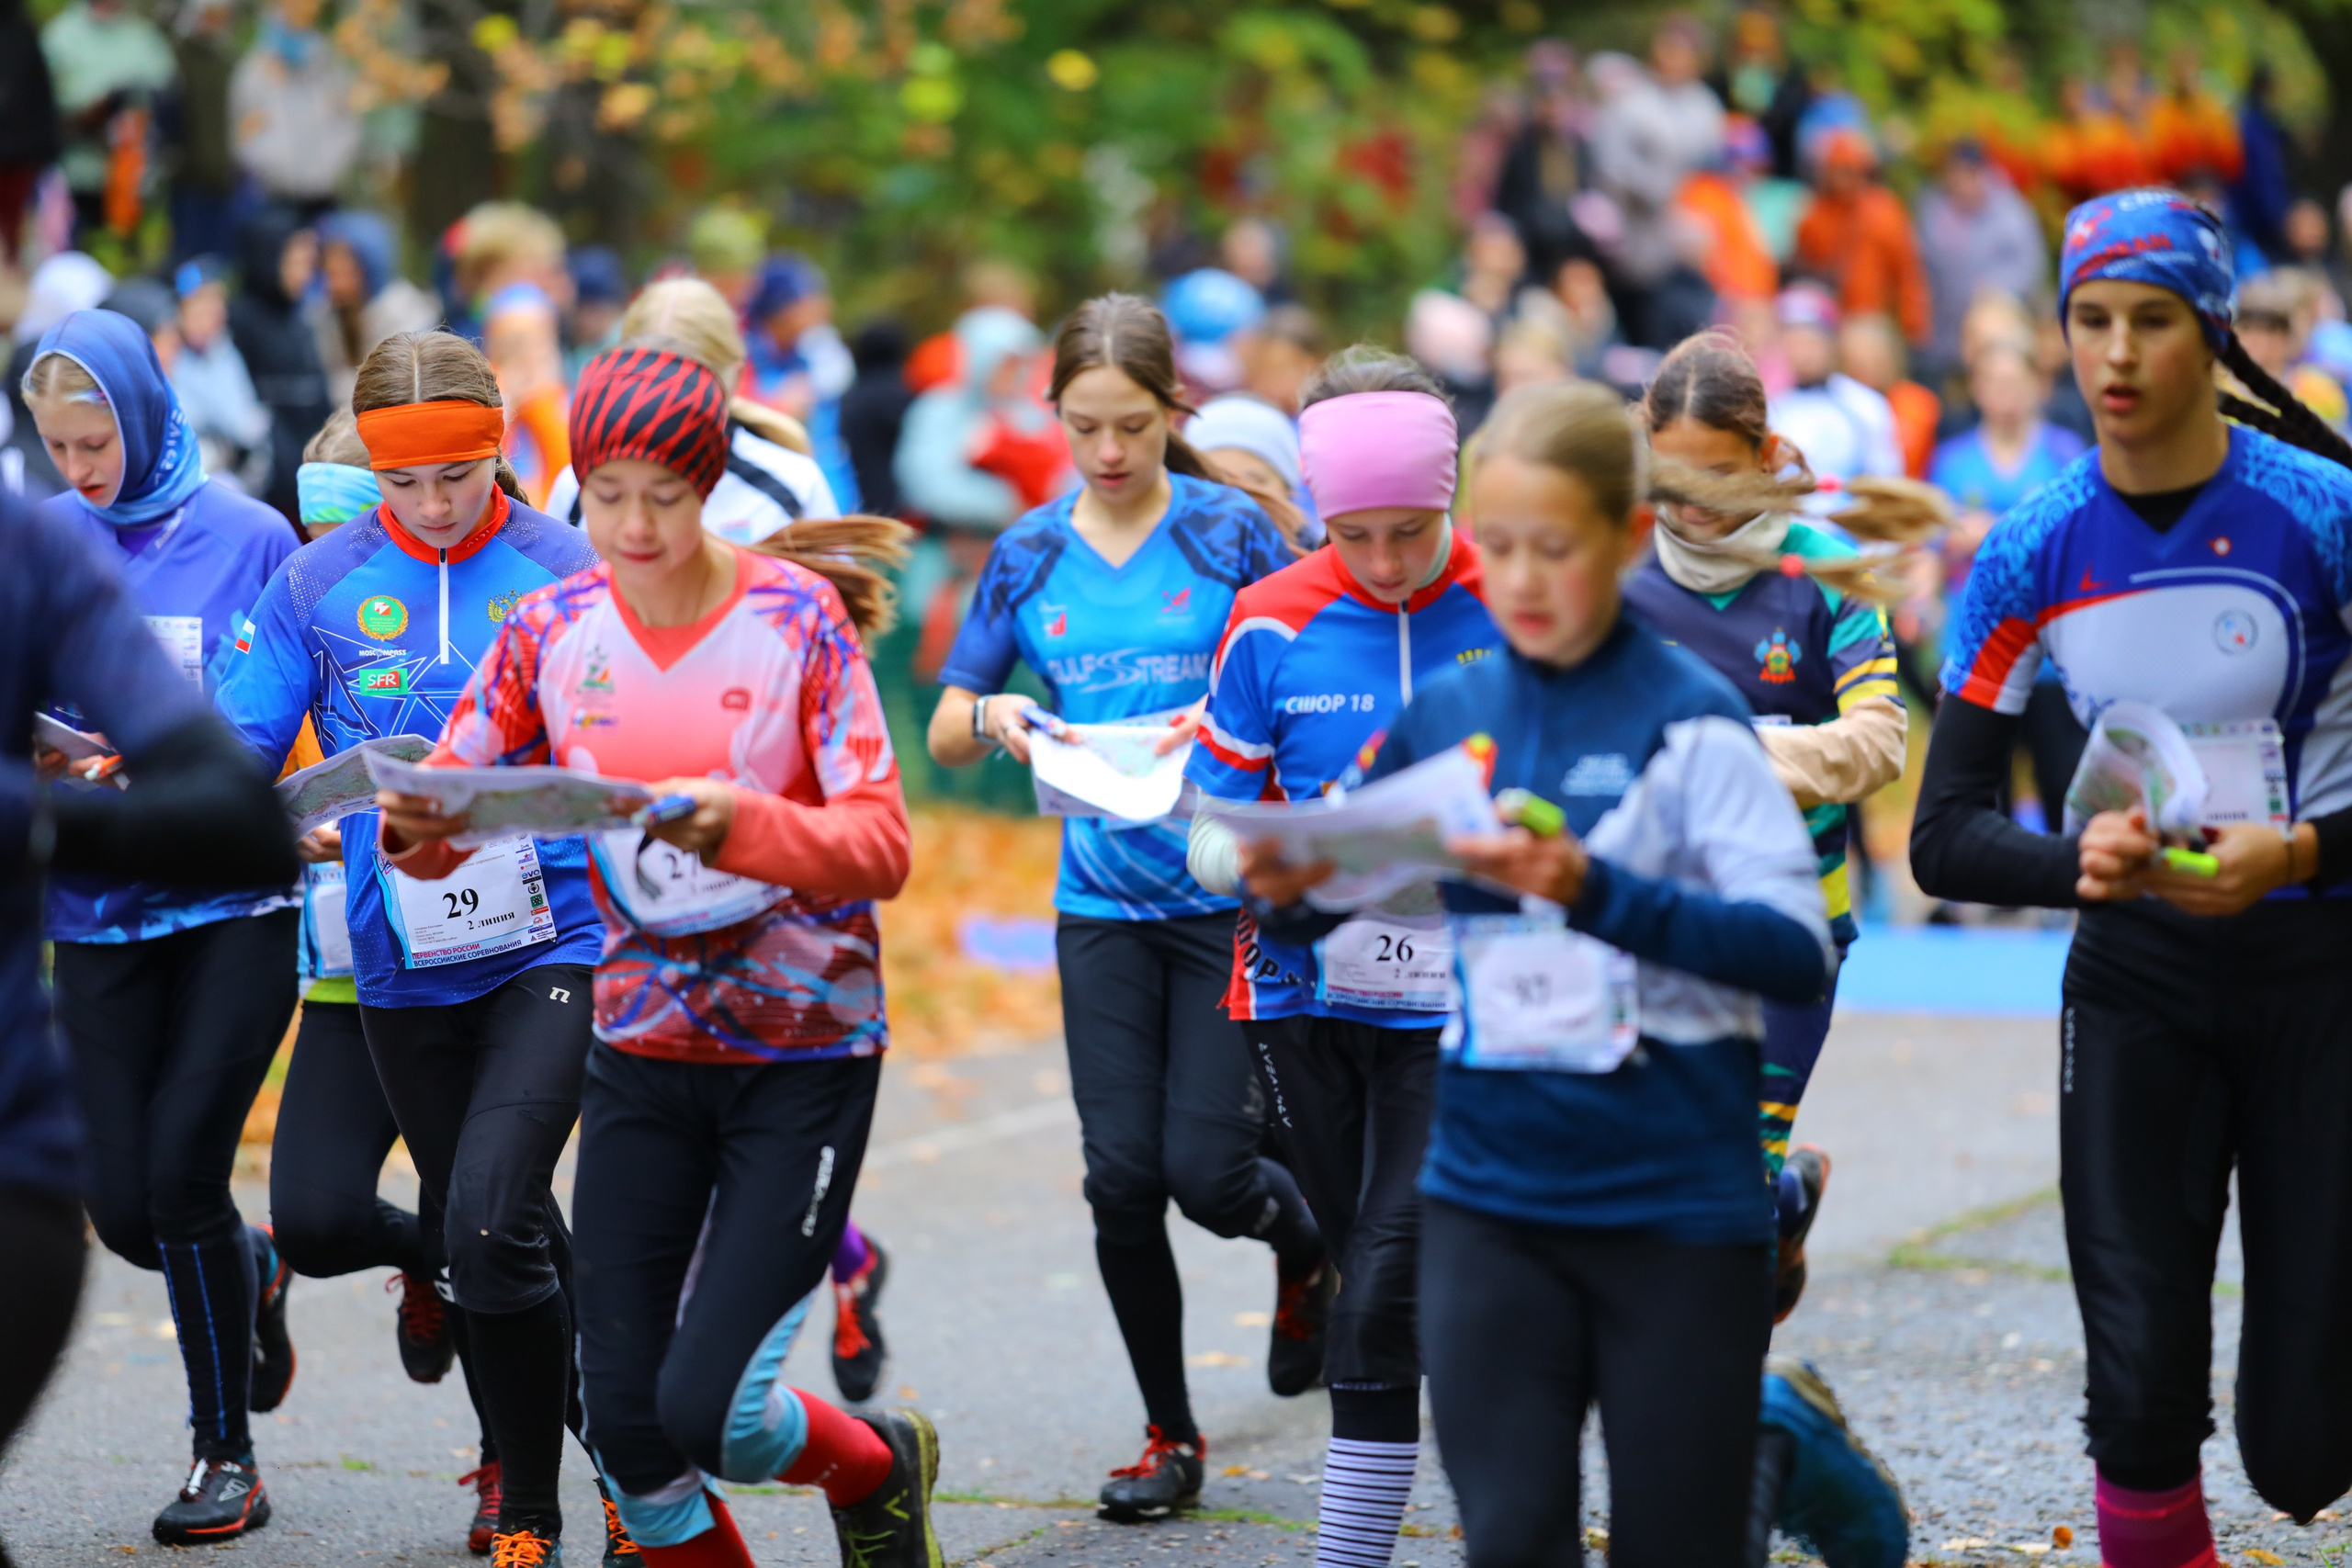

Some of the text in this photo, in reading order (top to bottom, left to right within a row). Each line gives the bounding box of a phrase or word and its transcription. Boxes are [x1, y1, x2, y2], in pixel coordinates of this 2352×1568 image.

[368, 673, 397, 686] SFR
[1284, 693, 1375, 715] СШОР 18
[521, 869, 540, 880] evo
[442, 888, 480, 919] 29
[467, 920, 474, 931] 2
[412, 943, 481, 960] ПЕРВЕНСТВО РОССИИ
[467, 940, 523, 959] СОРЕВНОВАНИЯ
[1375, 934, 1414, 963] 26
